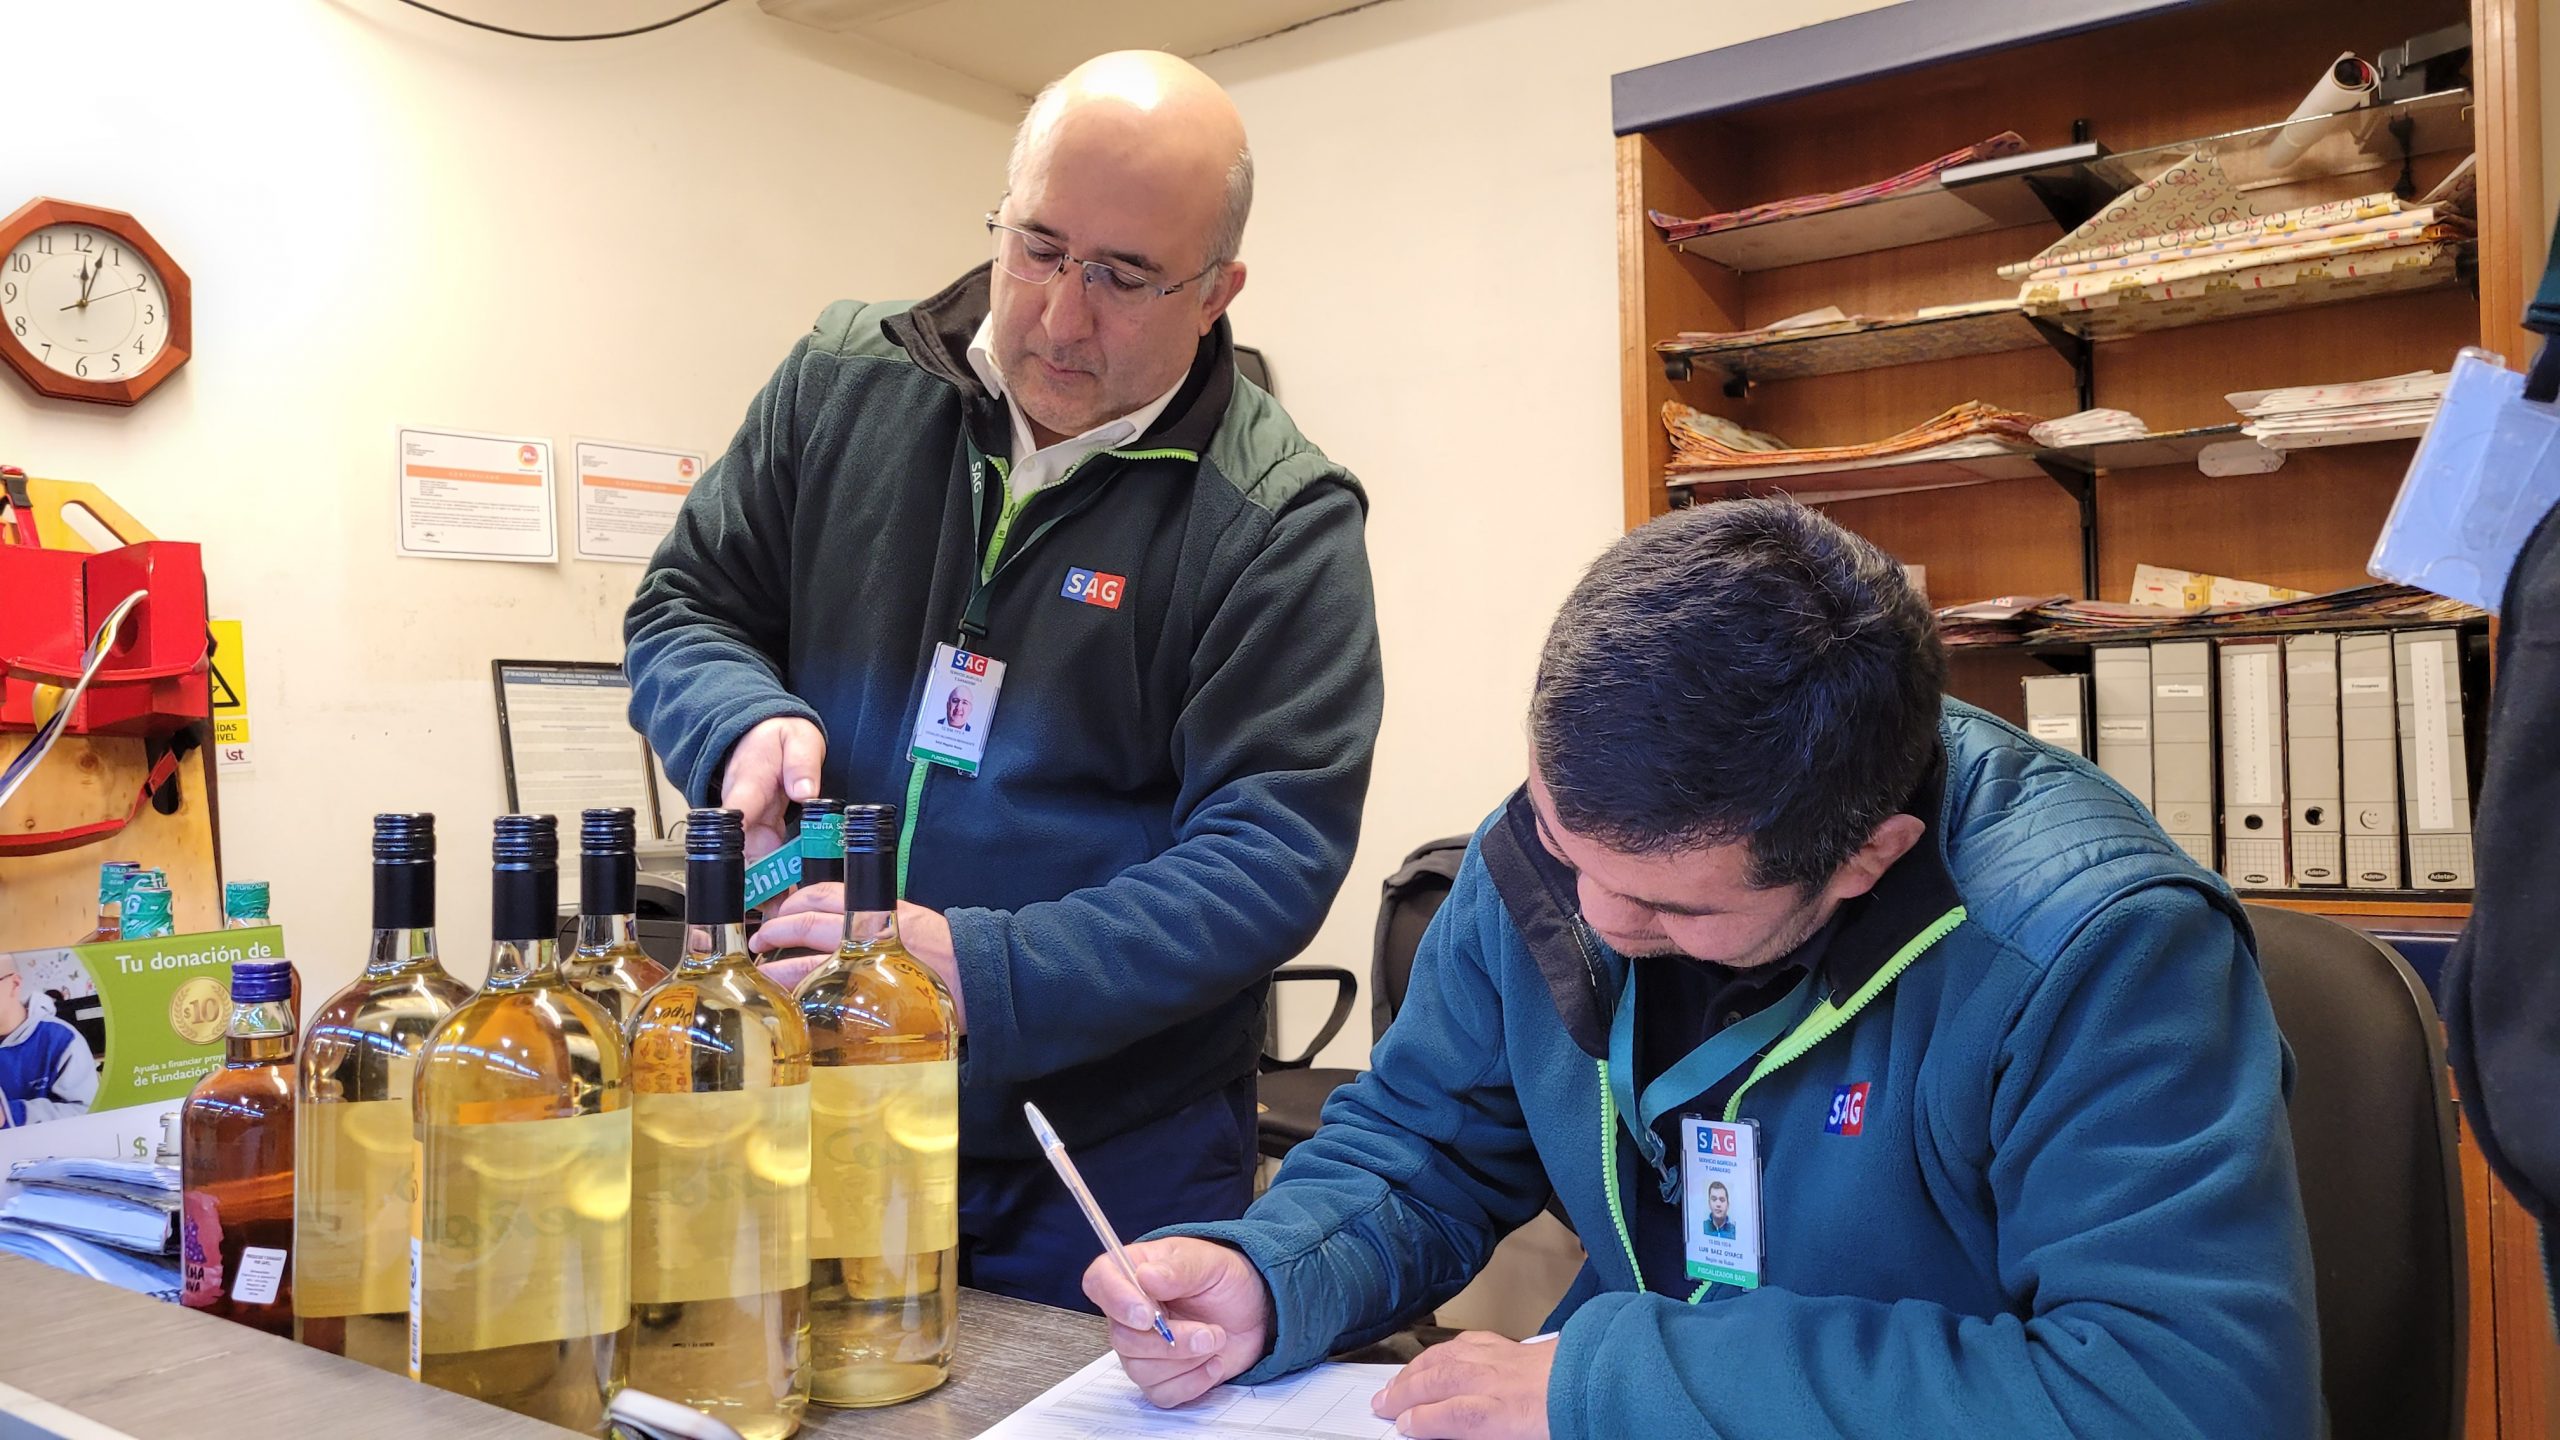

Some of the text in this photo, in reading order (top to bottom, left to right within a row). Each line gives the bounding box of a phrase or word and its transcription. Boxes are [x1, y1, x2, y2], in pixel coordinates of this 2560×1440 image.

[37, 235, 54, 255] 11
[74, 233, 93, 254] 12
[12, 253, 31, 274] 10
[113, 248, 120, 267] 1
[4, 282, 17, 304] 9
[136, 273, 147, 293] 2
[15, 316, 27, 336] 8
[143, 305, 155, 326] 3
[41, 343, 52, 363] 7
[133, 334, 145, 355] 4
[75, 356, 88, 377] 6
[111, 353, 121, 373] 5
[971, 461, 981, 495] SAG
[1067, 572, 1119, 603] SAG
[955, 653, 985, 673] SAG
[216, 722, 238, 732] ÍDAS
[217, 733, 236, 742] IVEL
[226, 748, 245, 761] ist
[115, 942, 271, 974] Tu donación de
[183, 997, 221, 1025] $10
[133, 1061, 160, 1075] Ayuda
[168, 1057, 202, 1070] financiar
[204, 1054, 226, 1065] proye
[134, 1076, 148, 1087] de
[151, 1066, 209, 1084] Fundación
[1828, 1091, 1862, 1125] SAG
[1698, 1131, 1735, 1153] SAG
[185, 1264, 205, 1282] CHA
